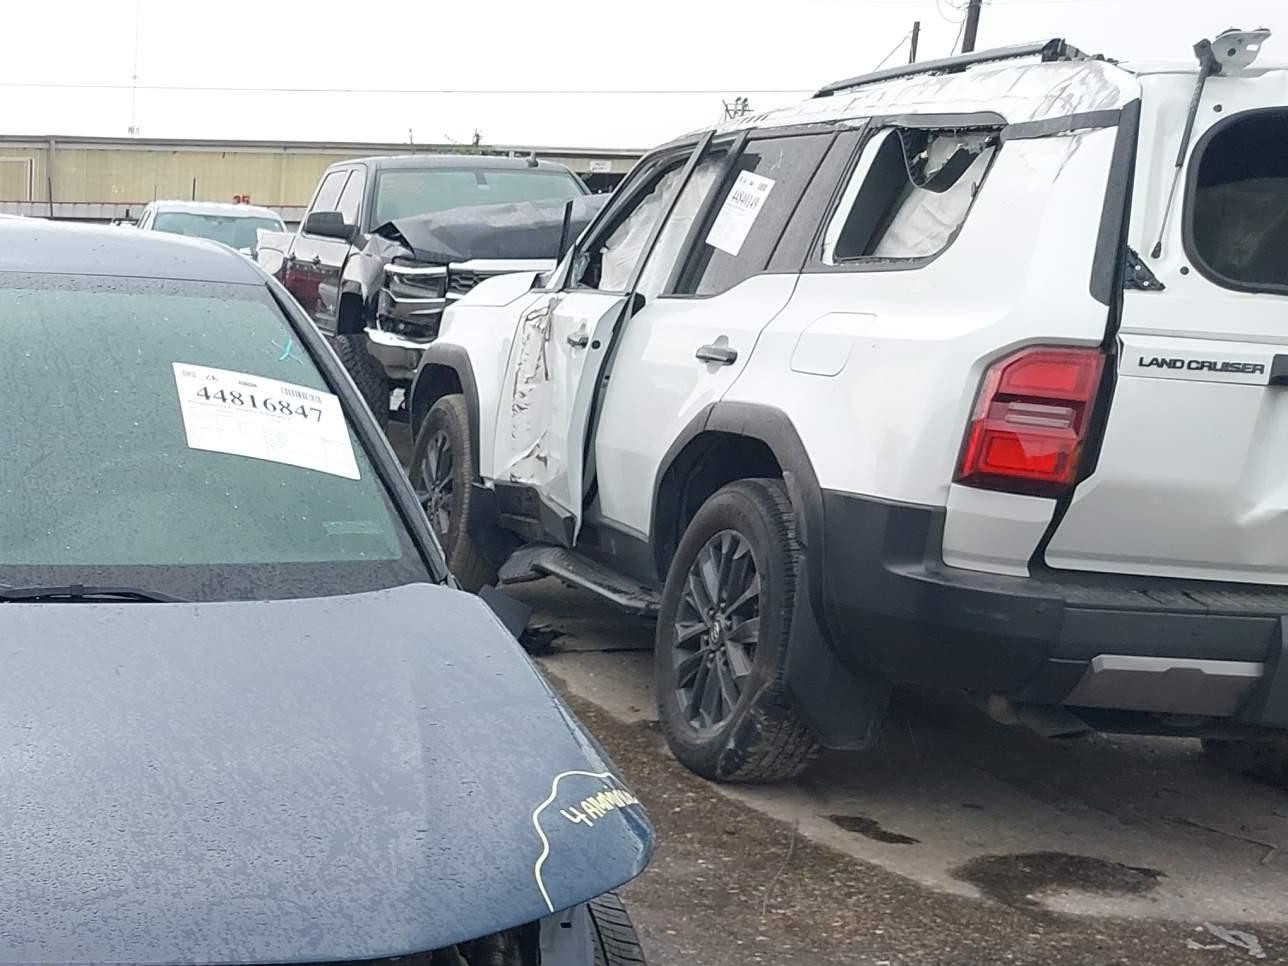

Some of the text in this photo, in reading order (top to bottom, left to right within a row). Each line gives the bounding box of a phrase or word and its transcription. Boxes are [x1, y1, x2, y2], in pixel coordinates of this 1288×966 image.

[1138, 356, 1265, 375] LAND CRUISER
[196, 385, 323, 423] 44816847
